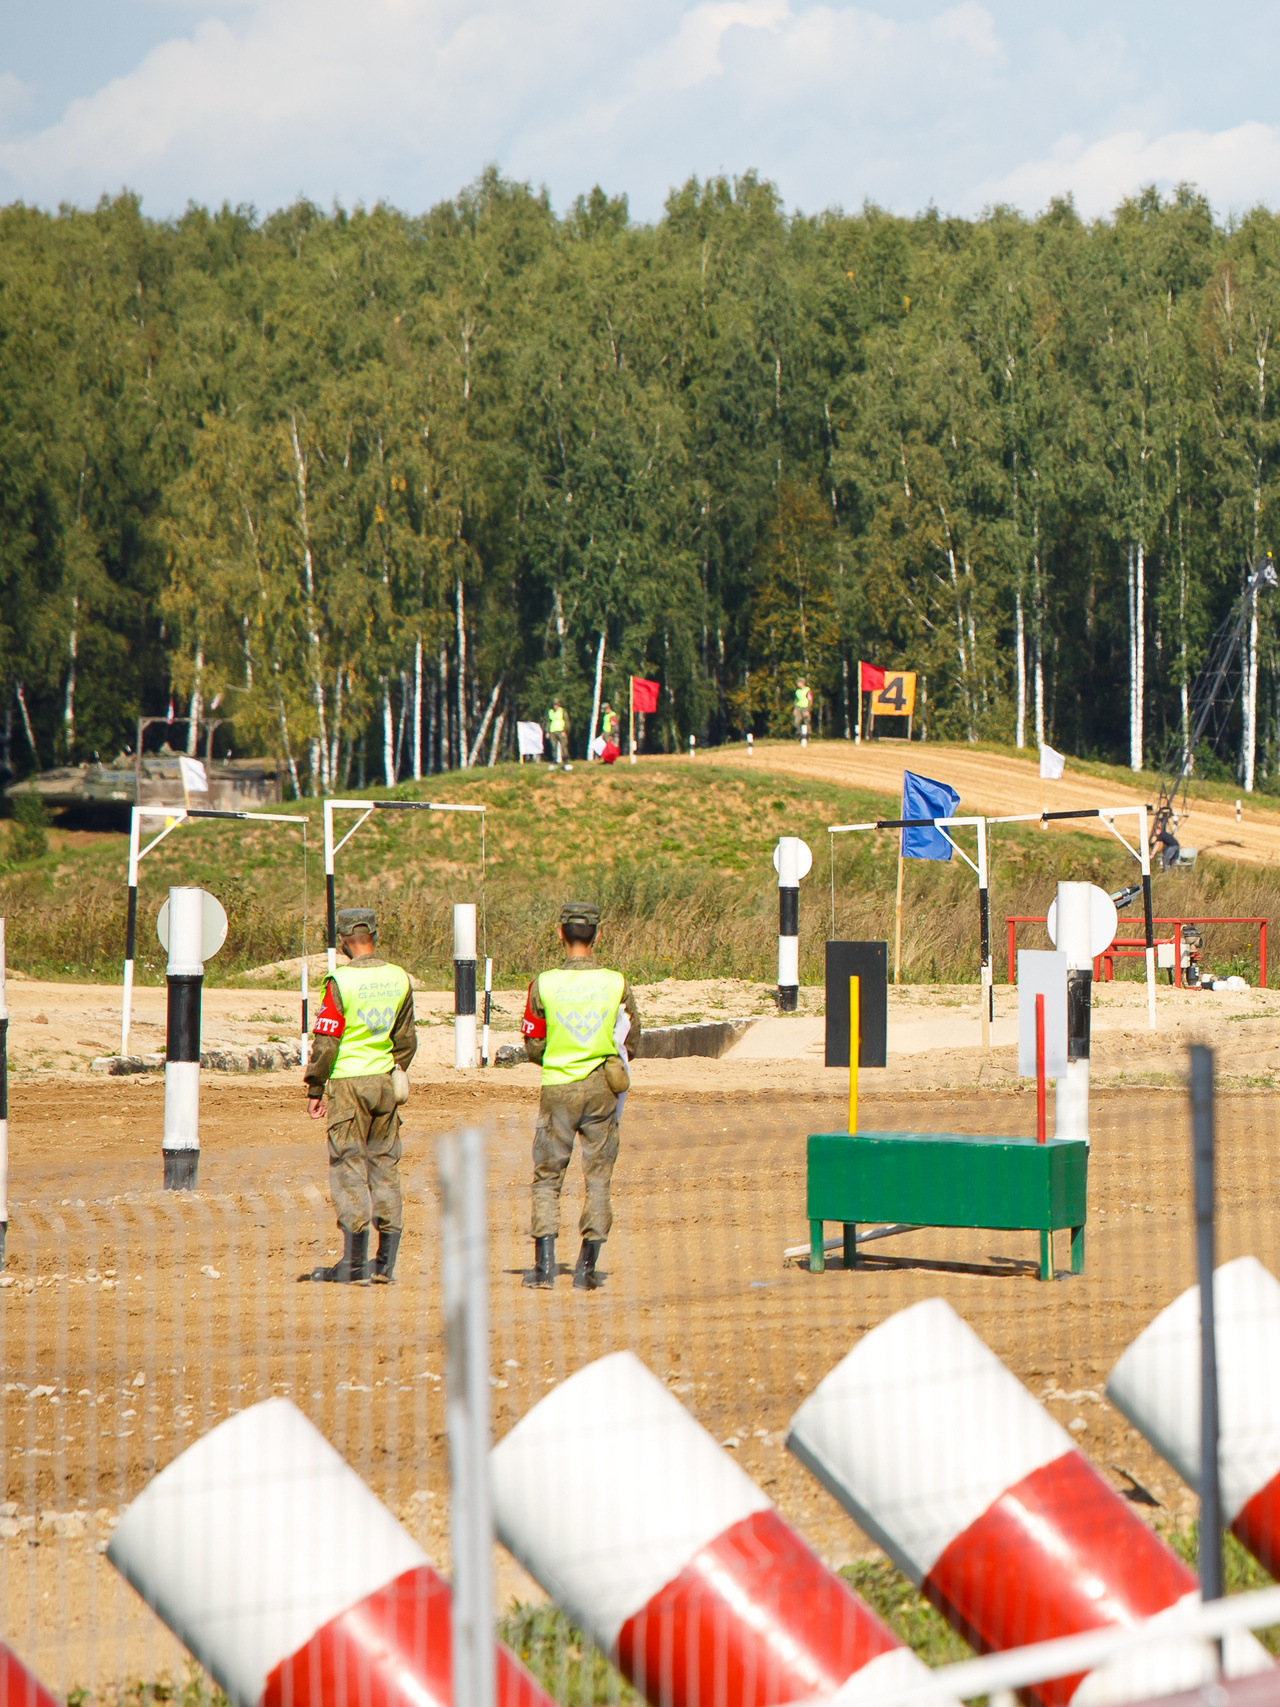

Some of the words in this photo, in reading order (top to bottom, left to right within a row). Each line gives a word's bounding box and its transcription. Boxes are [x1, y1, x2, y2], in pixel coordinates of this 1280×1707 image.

[878, 677, 907, 711] 4
[359, 981, 399, 991] ARMY
[556, 984, 609, 994] ARMY
[358, 989, 402, 1000] GAMES
[555, 993, 609, 1002] GAMES
